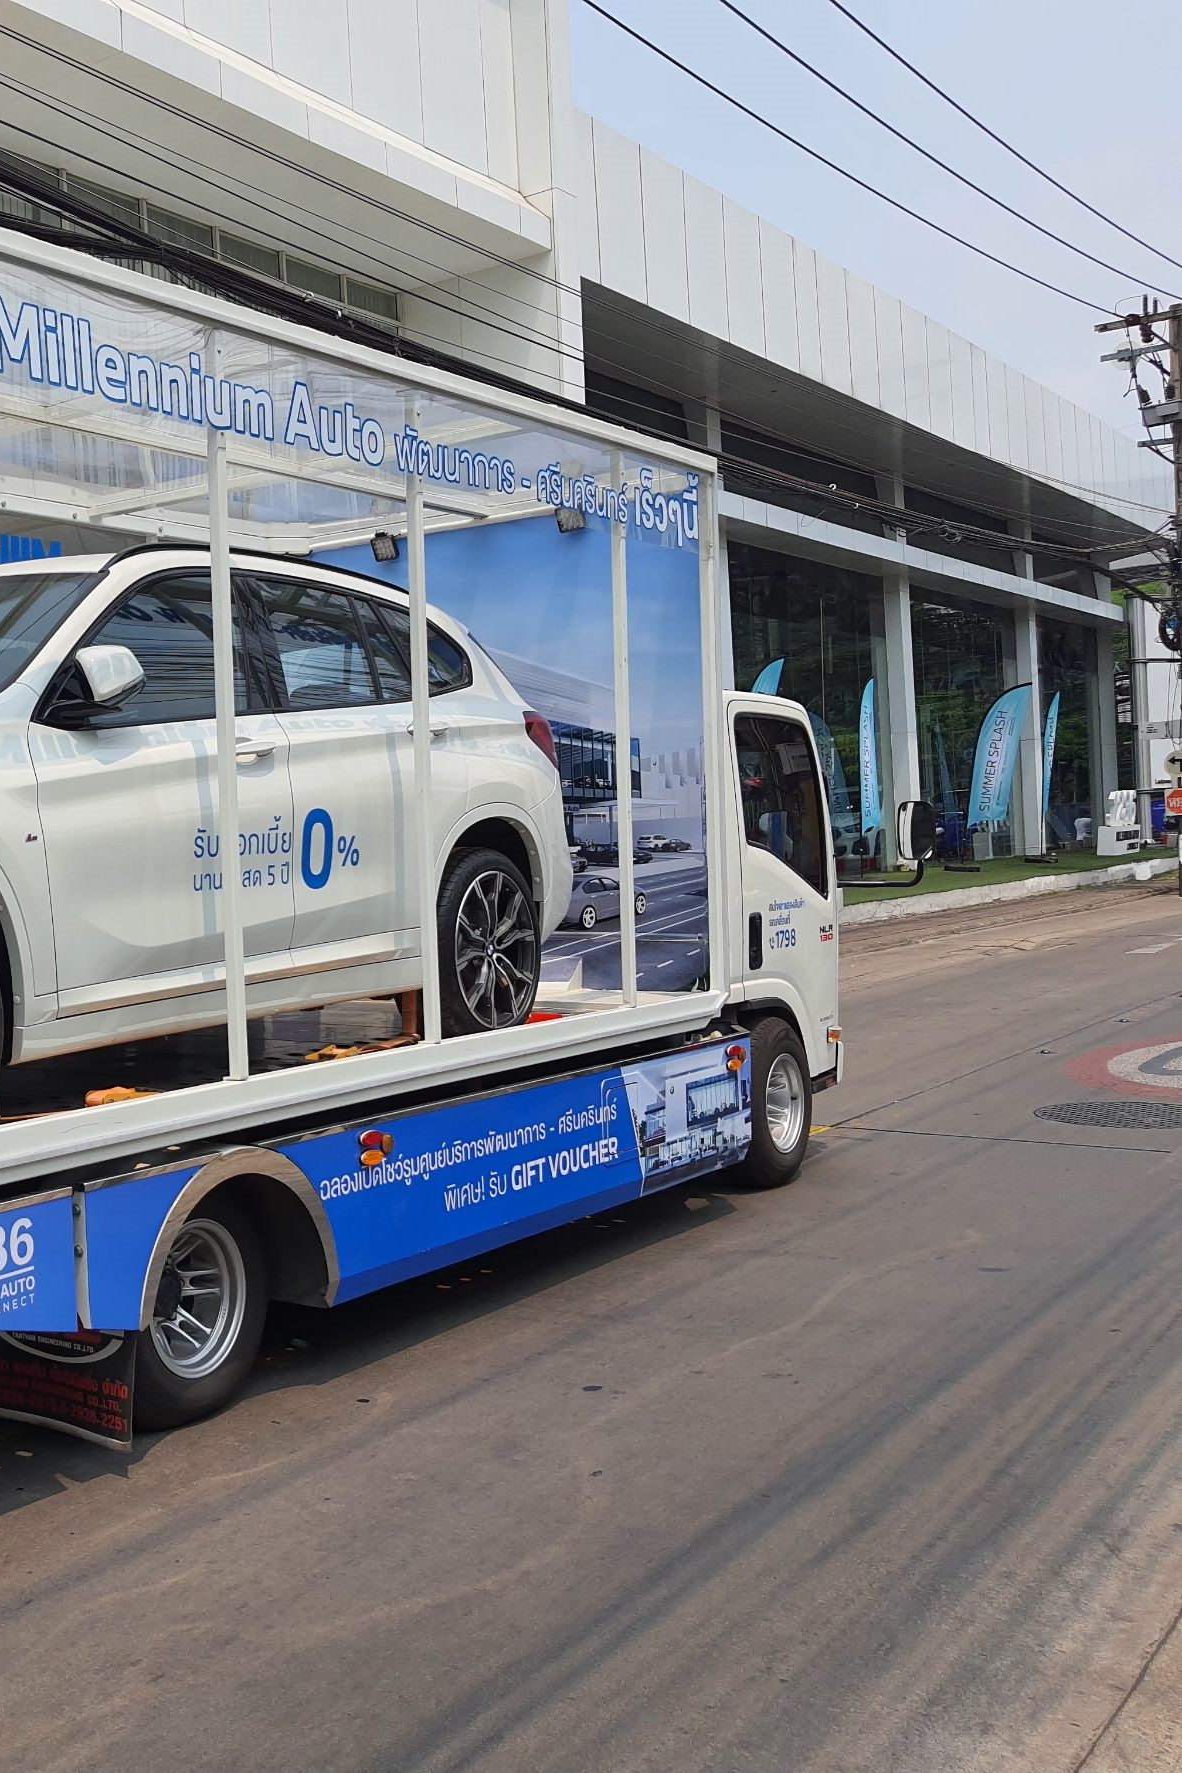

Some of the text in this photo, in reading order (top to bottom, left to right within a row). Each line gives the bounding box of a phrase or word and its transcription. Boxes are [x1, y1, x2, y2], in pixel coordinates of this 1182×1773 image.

[284, 380, 385, 467] Auto
[394, 425, 516, 494] พัฒนาการ
[537, 463, 629, 523] ศรีนครินทร์
[979, 710, 1008, 812] SUMMER SPLASH
[775, 928, 796, 949] 1798
[819, 924, 833, 934] NLR
[820, 933, 833, 942] 130
[489, 1171, 507, 1197] รับ
[511, 1158, 546, 1191] GIFT
[548, 1136, 619, 1179] VOUCHER
[0, 1275, 36, 1299] AUTO
